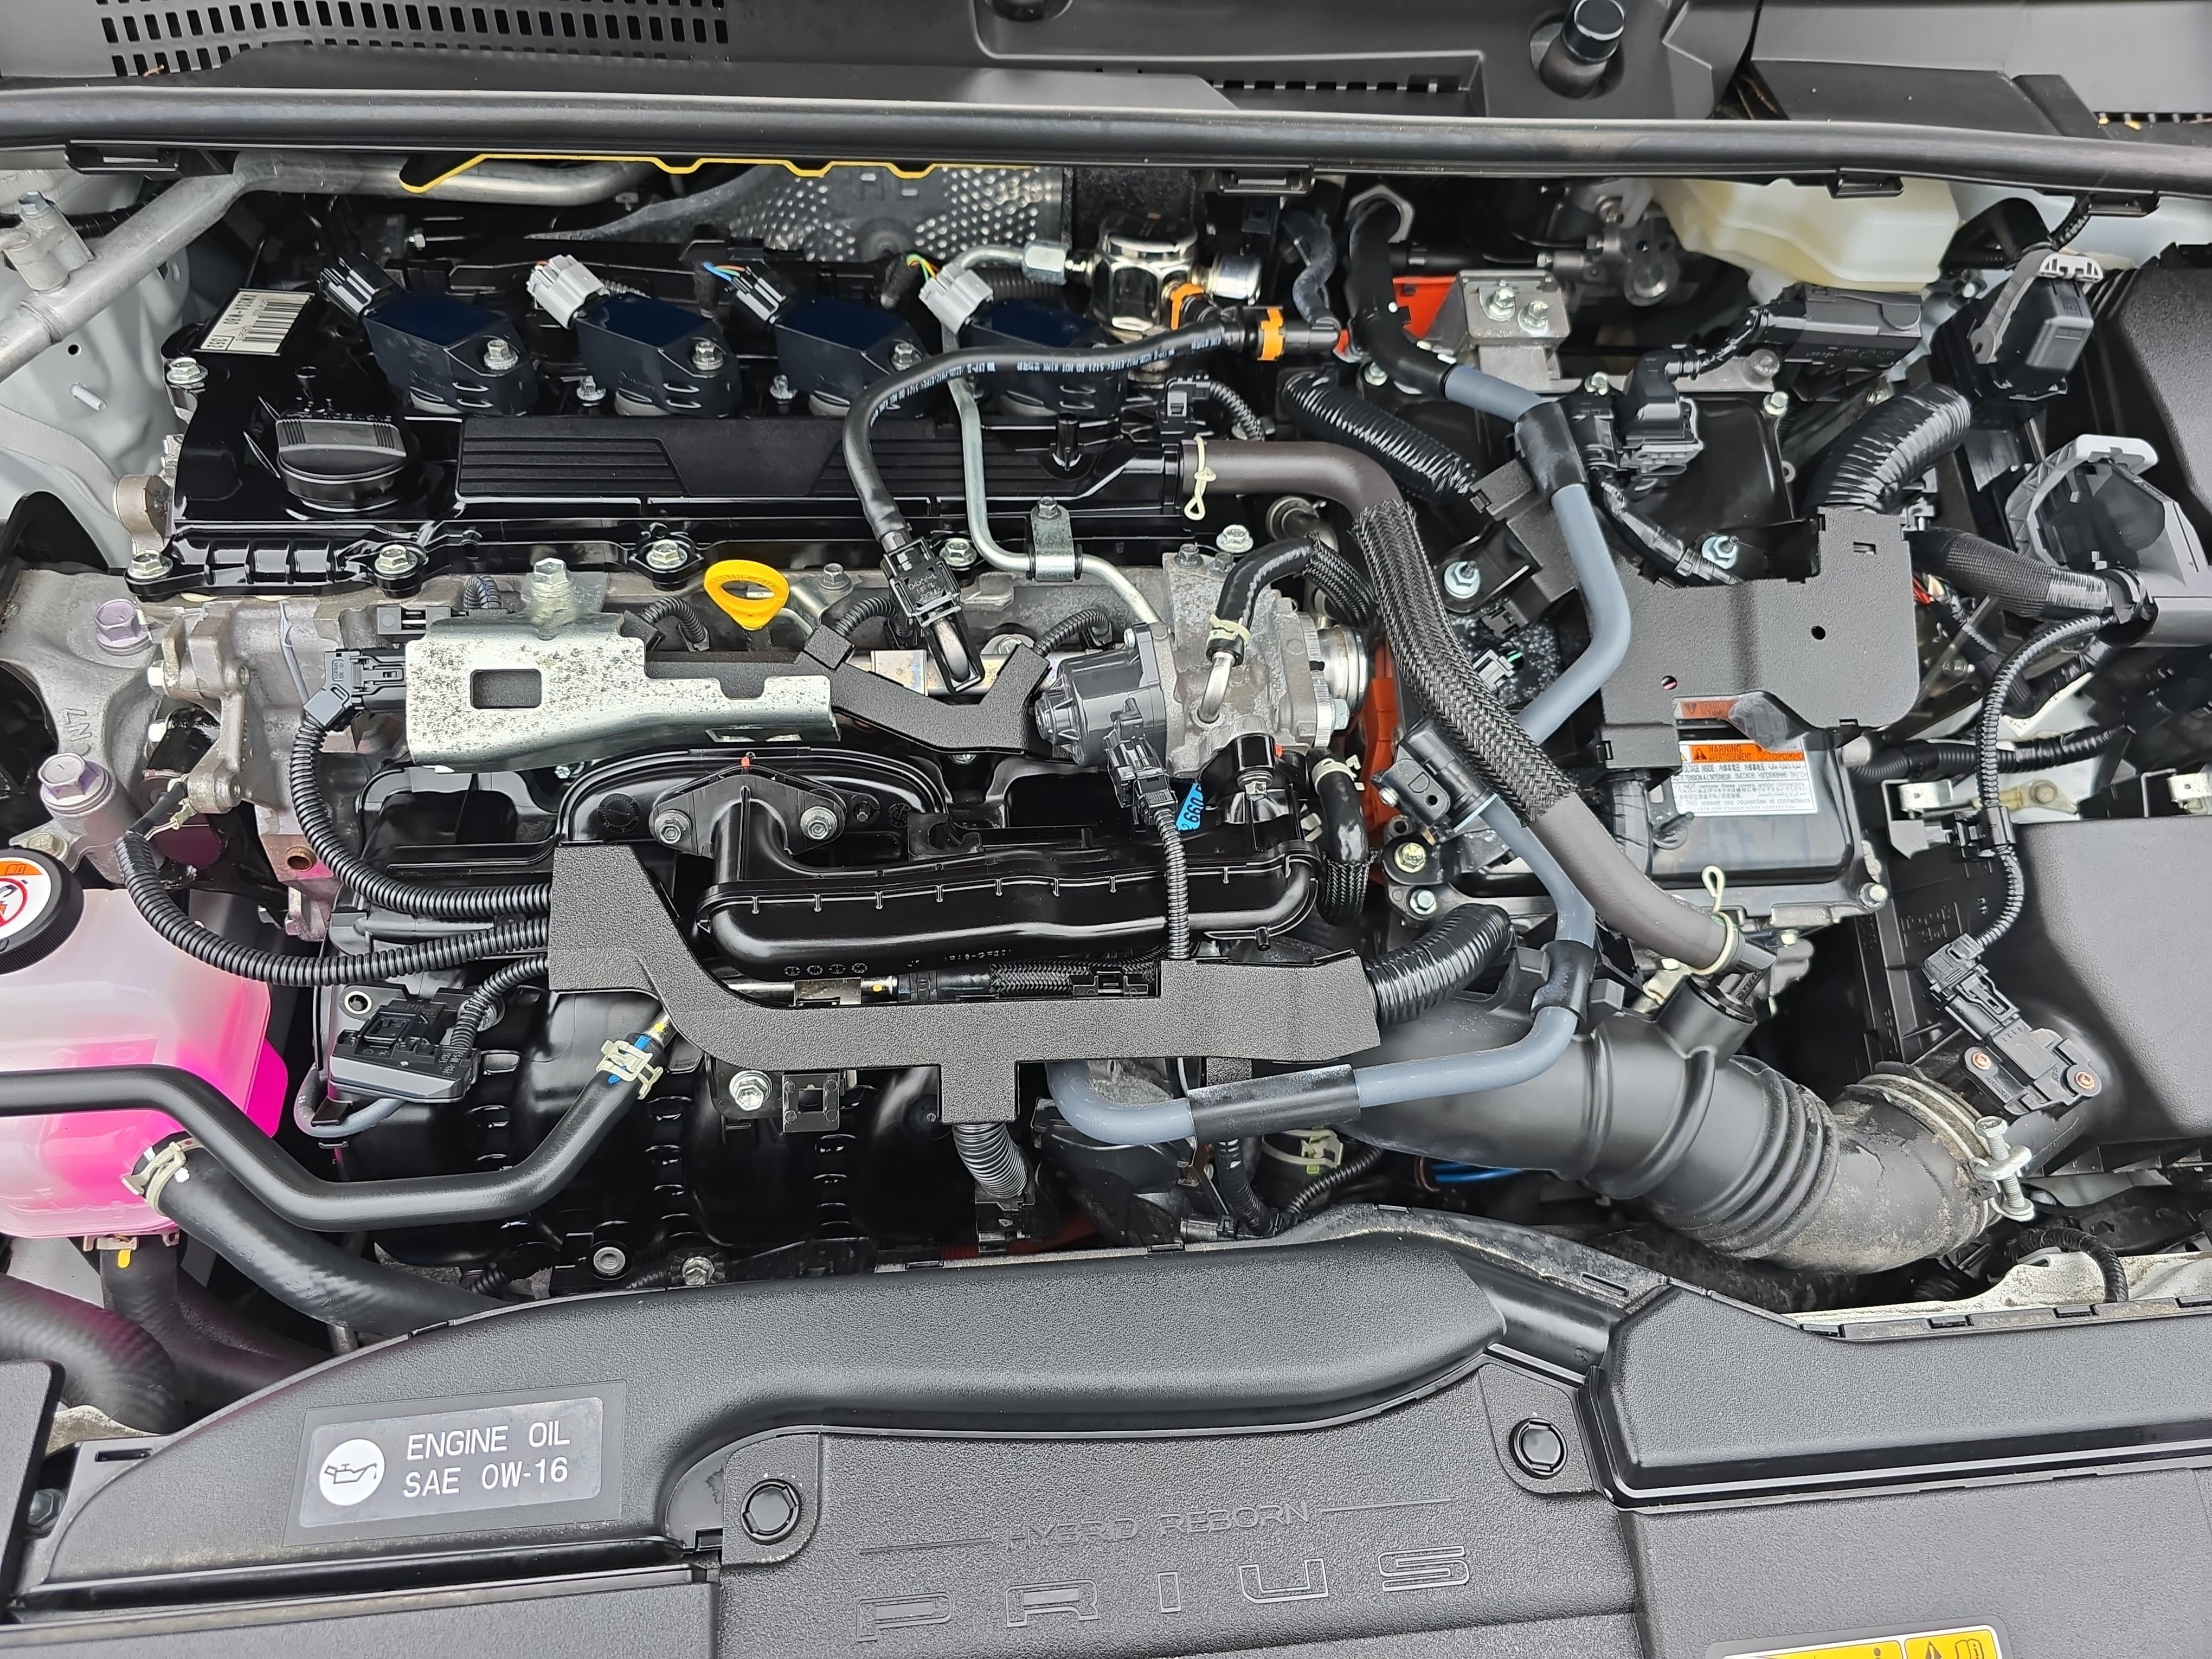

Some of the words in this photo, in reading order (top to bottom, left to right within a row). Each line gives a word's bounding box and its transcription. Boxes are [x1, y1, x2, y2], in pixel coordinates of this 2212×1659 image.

[1709, 753, 1751, 761] AVERTISSEMENT
[406, 1425, 509, 1461] ENGINE
[529, 1420, 571, 1449] OIL
[403, 1467, 461, 1499] SAE
[481, 1456, 569, 1490] 0W-16
[1005, 1516, 1140, 1551] HYBRID
[1158, 1501, 1310, 1535] REBORN
[856, 1544, 1470, 1642] PRIUS
